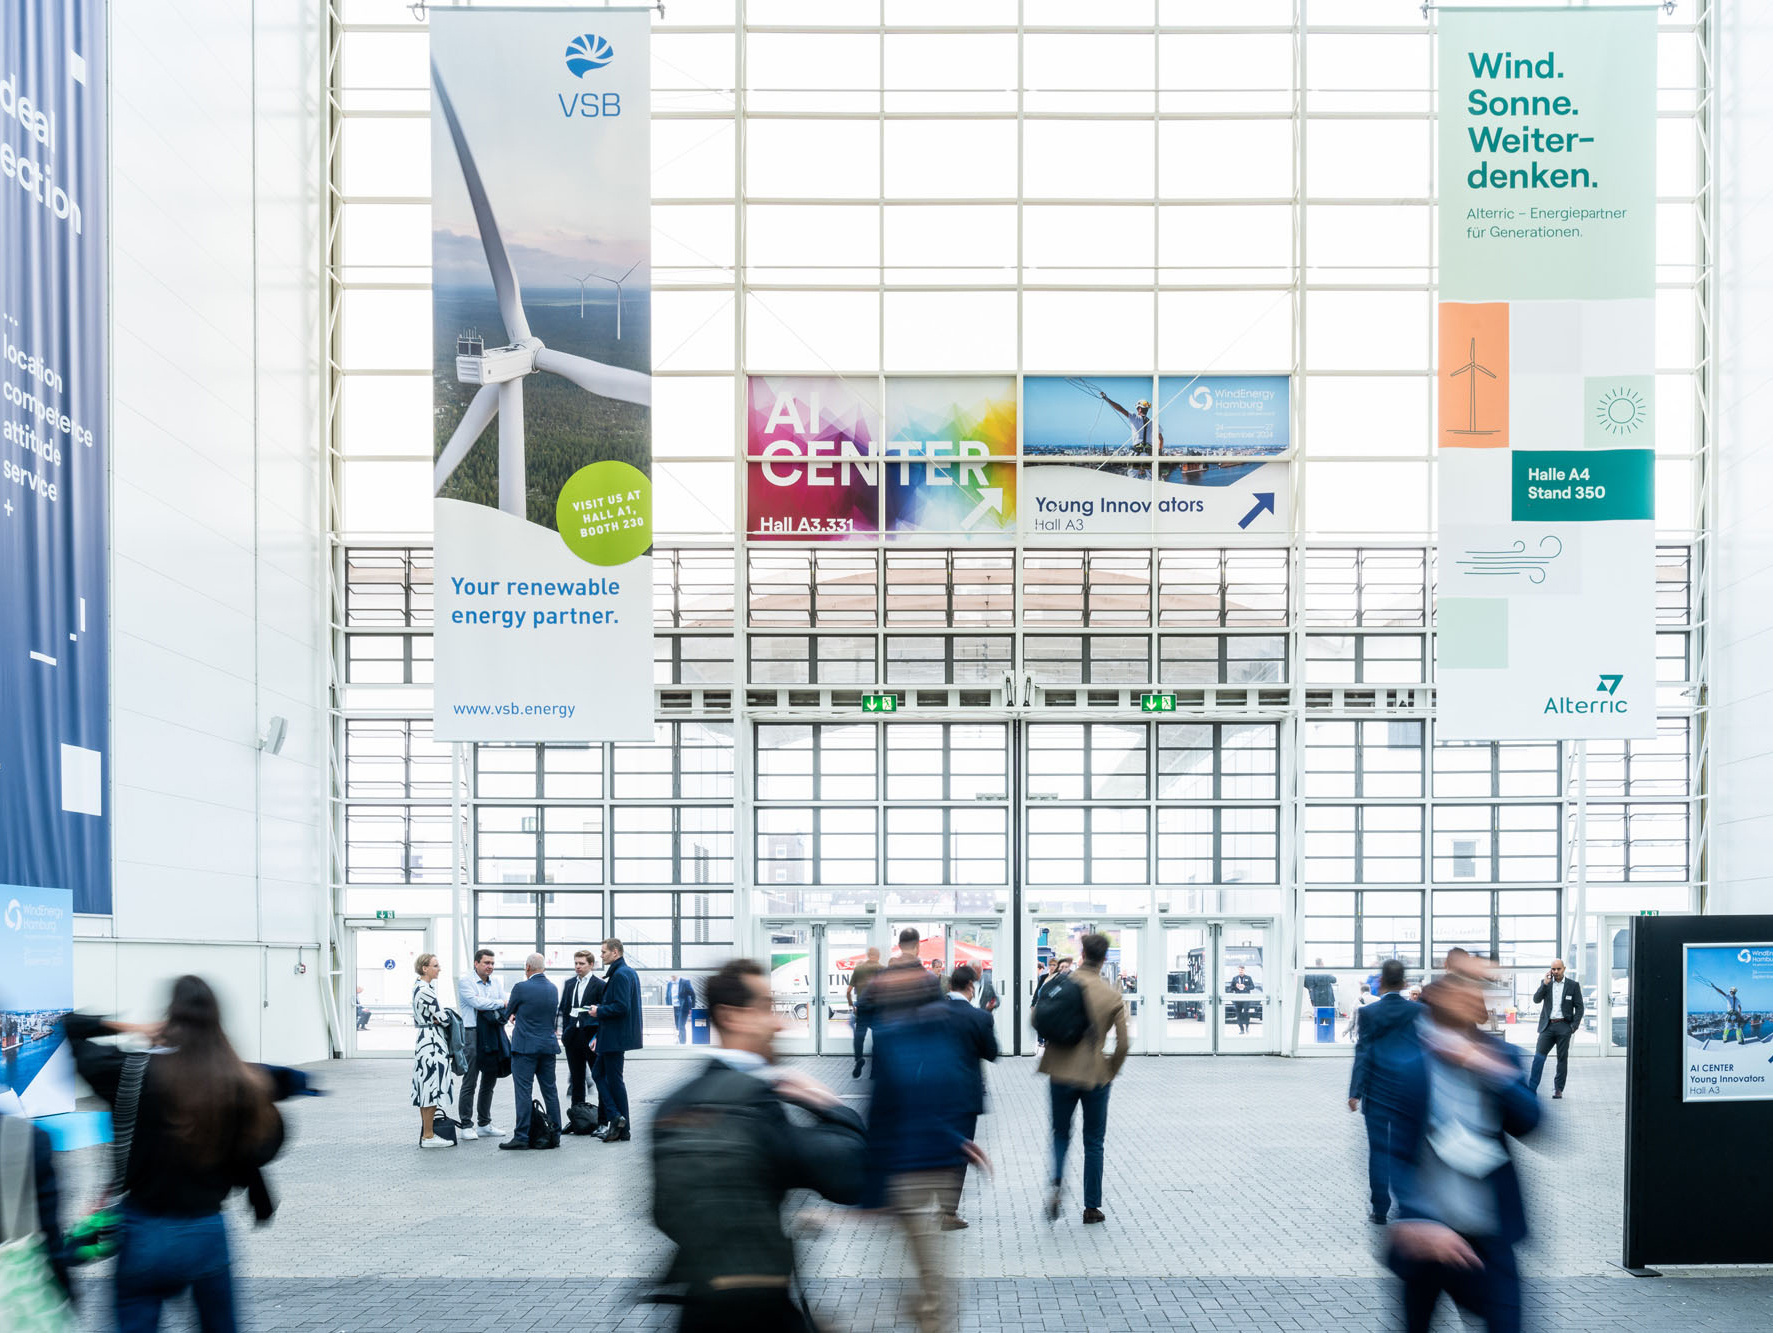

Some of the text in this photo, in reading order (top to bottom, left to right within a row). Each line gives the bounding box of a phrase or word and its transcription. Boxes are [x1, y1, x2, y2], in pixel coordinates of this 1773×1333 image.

[1468, 51, 1564, 79] Wind.
[558, 92, 621, 117] VSB
[1467, 89, 1579, 116] Sonne.
[1467, 125, 1595, 153] Weiter-
[1467, 161, 1598, 189] denken.
[1466, 208, 1515, 220] Alterric
[1530, 207, 1628, 221] Energiepartner
[1467, 226, 1583, 239] für Generationen.
[3, 333, 63, 393] location
[1215, 388, 1275, 401] WindEnergy
[3, 381, 94, 448] competence
[764, 391, 820, 434] AI
[1215, 400, 1263, 411] Hamburg
[3, 420, 62, 467] attitude
[761, 440, 991, 487] CENTER
[3, 459, 58, 502] service
[1528, 467, 1591, 481] Halle A4
[572, 490, 641, 512] VISIT US AT
[1527, 486, 1606, 500] Stand 350
[583, 505, 637, 524] HALL A1,
[1035, 497, 1094, 517] Young
[580, 517, 644, 538] BOOTH 230
[760, 517, 854, 533] Hall A3.331
[1035, 519, 1084, 531] Hall A3
[451, 577, 620, 596] Your renewable
[451, 608, 619, 628] energy partner.
[453, 702, 576, 718] www.vsb.energy
[1543, 697, 1628, 714] Alterric
[1690, 1063, 1734, 1072] AI CENTER
[1690, 1074, 1765, 1085] Young Innovators
[1708, 1086, 1720, 1094] A3
